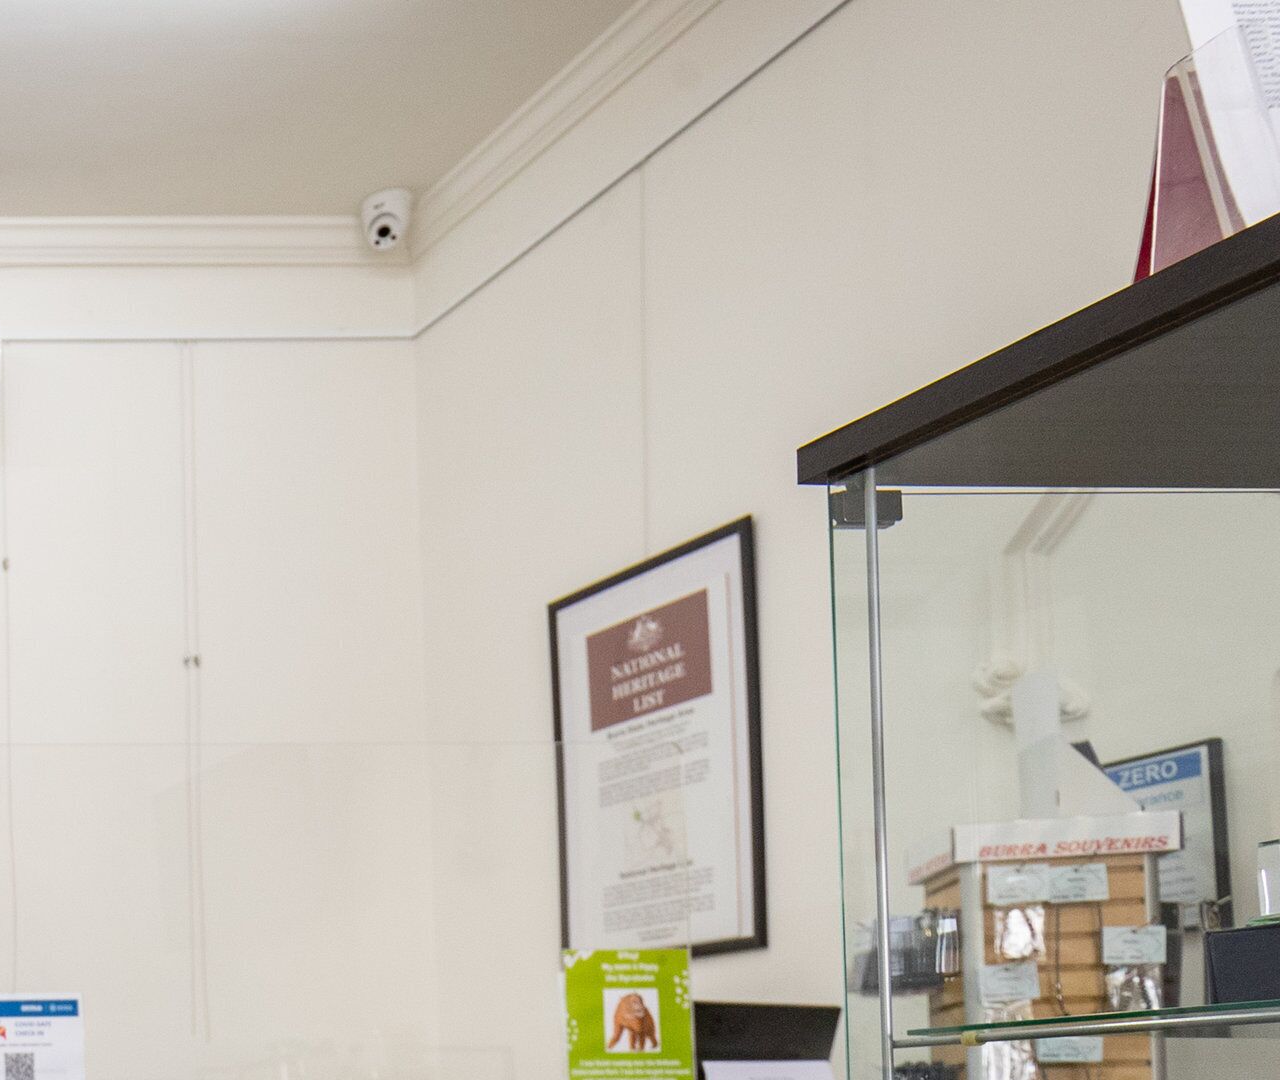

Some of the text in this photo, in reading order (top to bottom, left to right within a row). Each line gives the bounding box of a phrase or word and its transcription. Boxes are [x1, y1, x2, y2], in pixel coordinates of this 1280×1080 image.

[1118, 760, 1178, 790] ZERO
[980, 835, 1170, 858] BURRA SOUVENIRS
